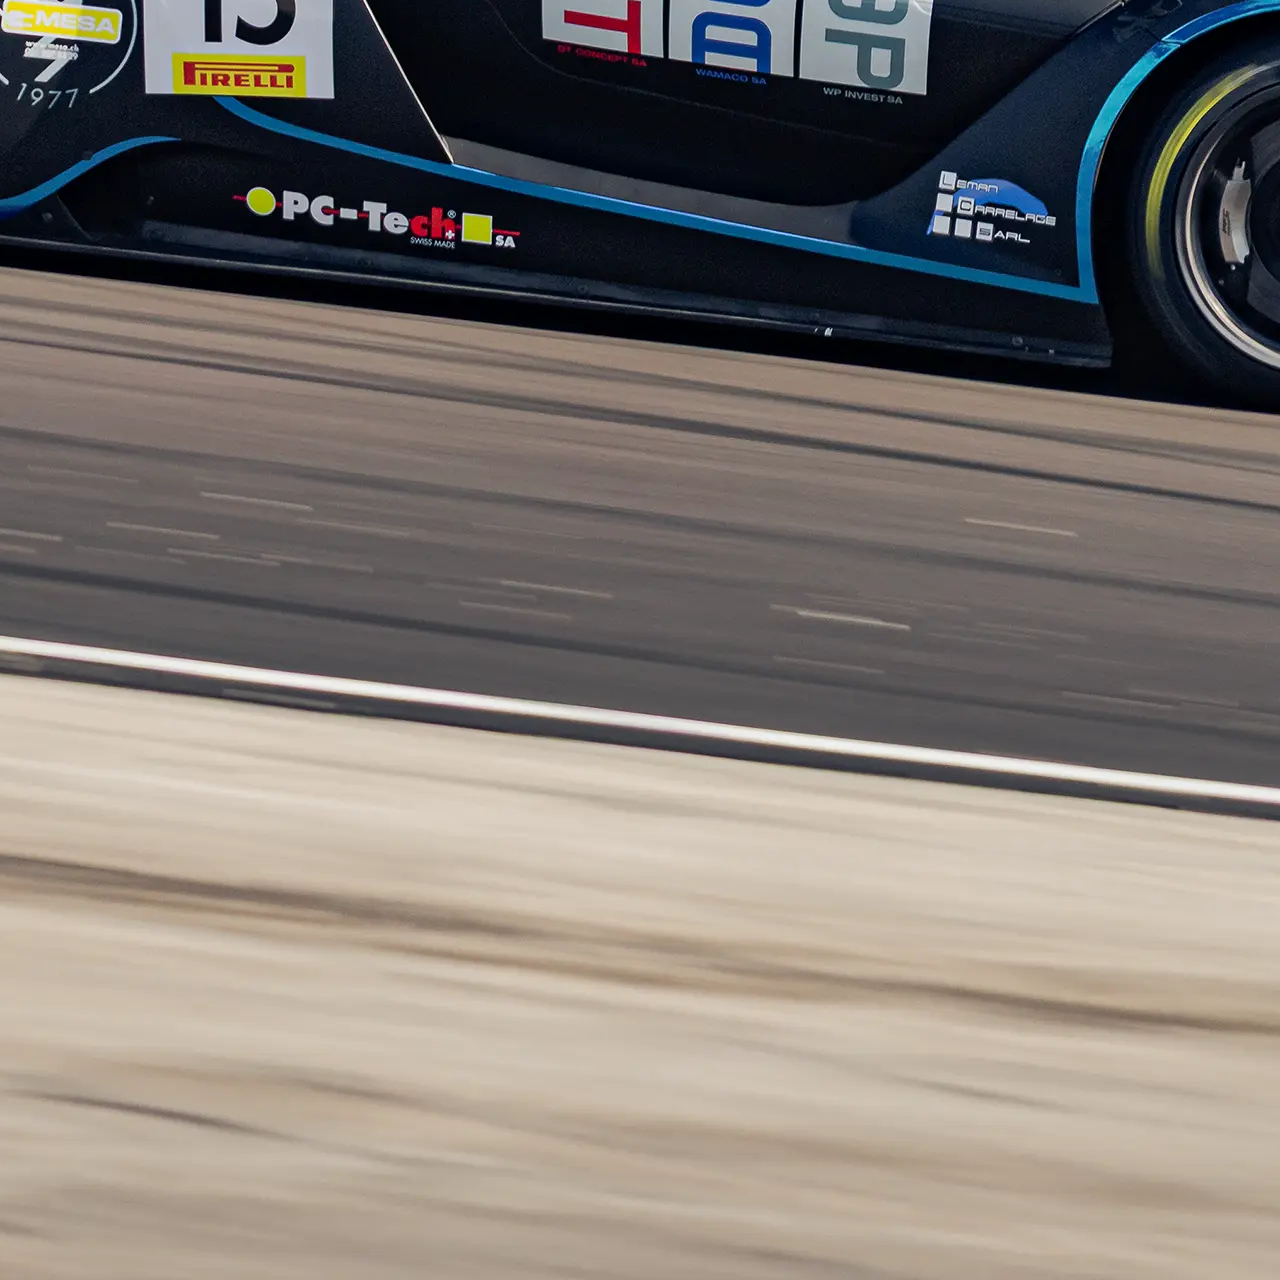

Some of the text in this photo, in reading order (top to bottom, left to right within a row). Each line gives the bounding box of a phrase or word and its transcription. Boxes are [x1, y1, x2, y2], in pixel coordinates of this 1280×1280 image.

[35, 10, 115, 35] MESA
[575, 47, 629, 64] CONCEPT
[183, 60, 295, 89] PIRELLI
[695, 68, 767, 85] WAMACO SA
[16, 83, 79, 109] 1977
[823, 86, 903, 105] WP INVEST SA
[410, 236, 456, 249] SWISS MADE
[495, 236, 516, 248] SA
